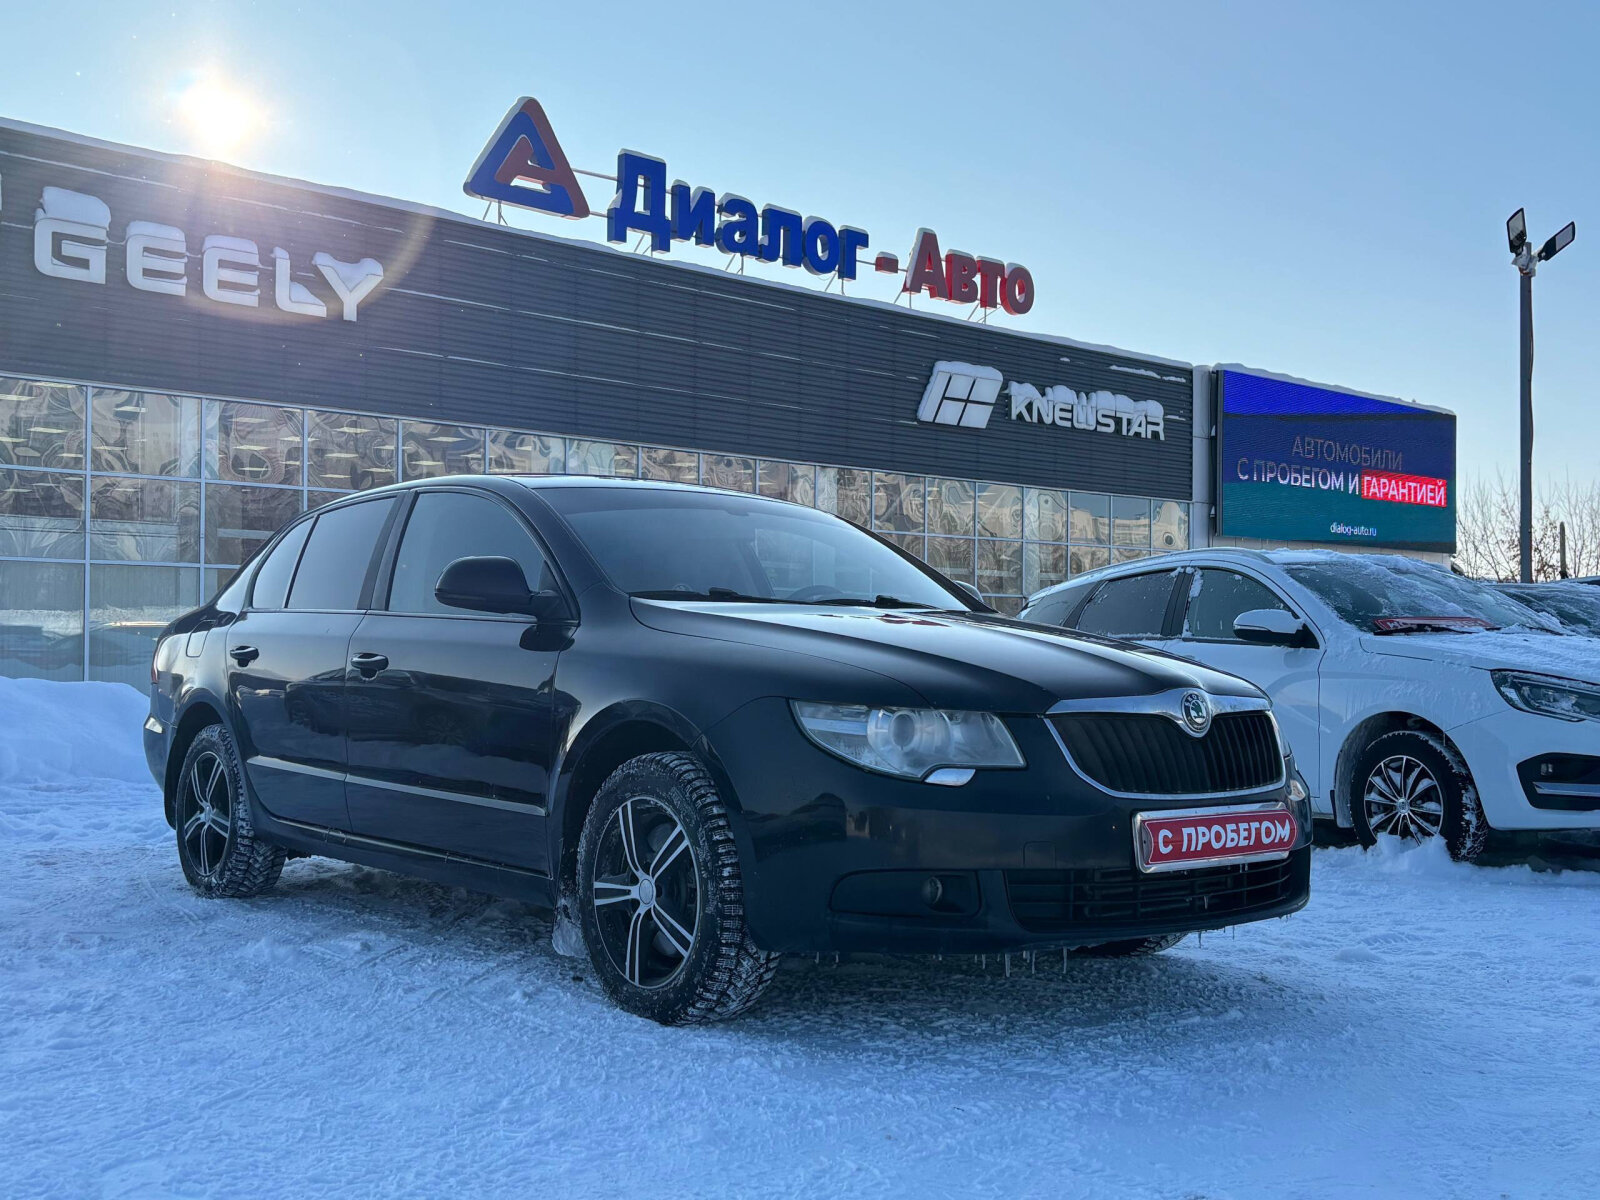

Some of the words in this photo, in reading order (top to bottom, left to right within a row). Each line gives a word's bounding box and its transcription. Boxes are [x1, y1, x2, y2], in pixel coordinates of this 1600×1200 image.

[33, 217, 384, 322] GEELY
[1010, 393, 1165, 441] KNEWSTAR
[1291, 435, 1403, 471] АВТОМОБИЛИ
[1237, 457, 1249, 481] С
[1253, 458, 1344, 492] ПРОБЕГОМ
[1348, 473, 1359, 495] И
[1363, 475, 1445, 506] ГАРАНТИЕЙ
[1330, 521, 1377, 537] dialog-auto.ru
[1158, 829, 1173, 854] С
[1181, 818, 1290, 853] ПРОБЕГОМ
